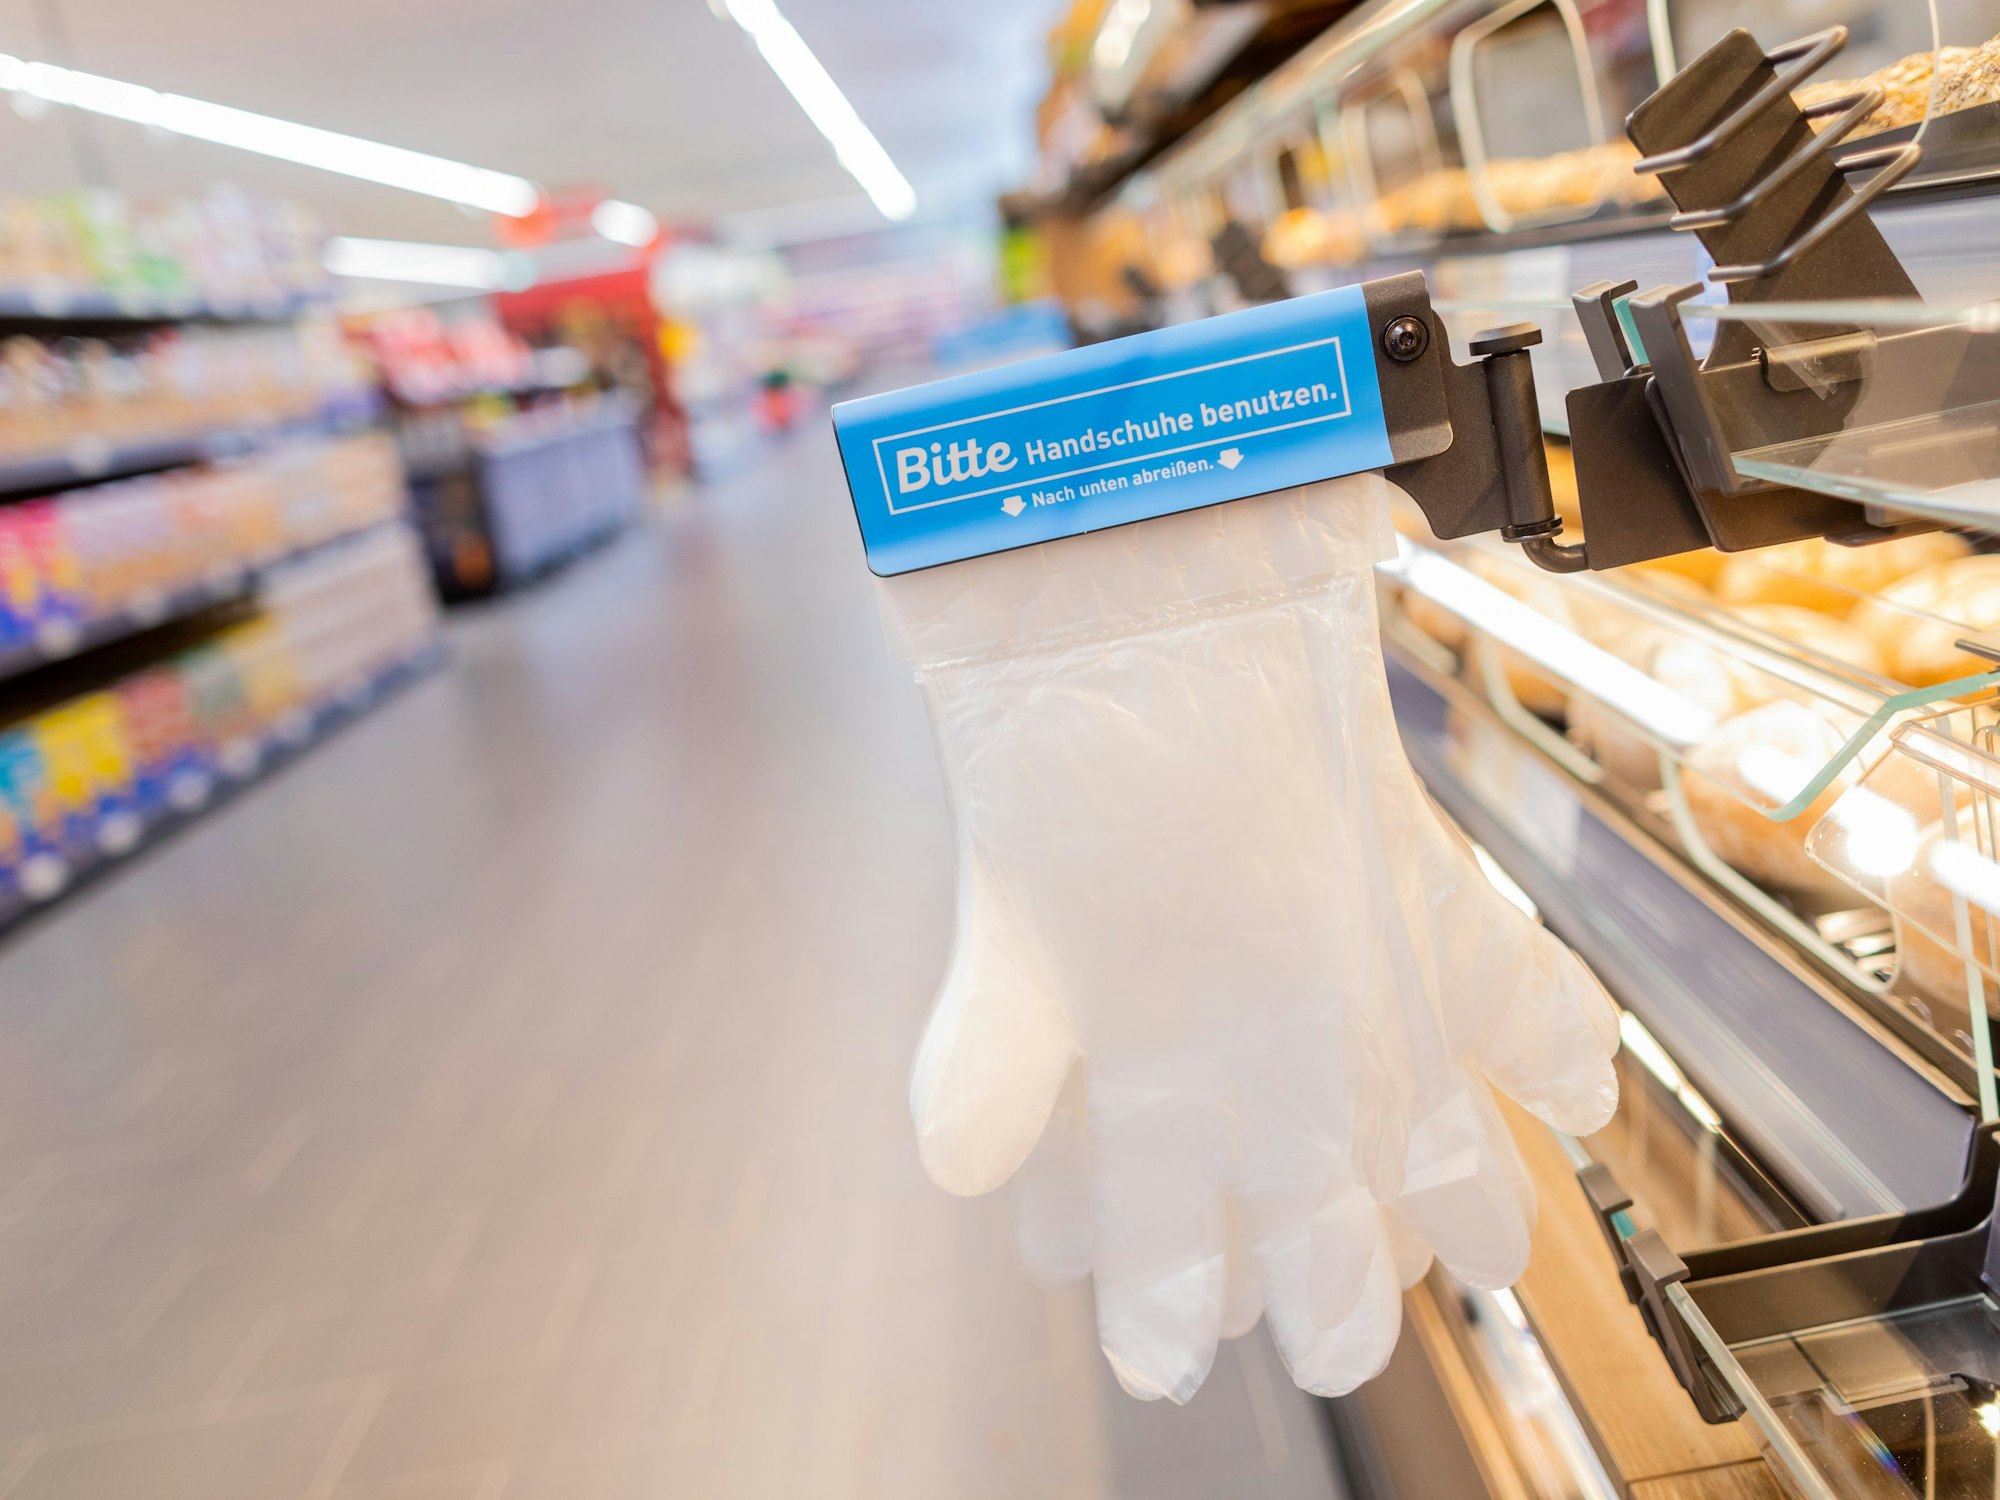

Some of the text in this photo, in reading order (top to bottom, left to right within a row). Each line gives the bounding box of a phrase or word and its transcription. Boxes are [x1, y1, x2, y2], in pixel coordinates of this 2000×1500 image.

[895, 383, 1337, 493] Bitte Handschuhe benutzen.
[1032, 459, 1214, 507] Nach unten abreißen.
